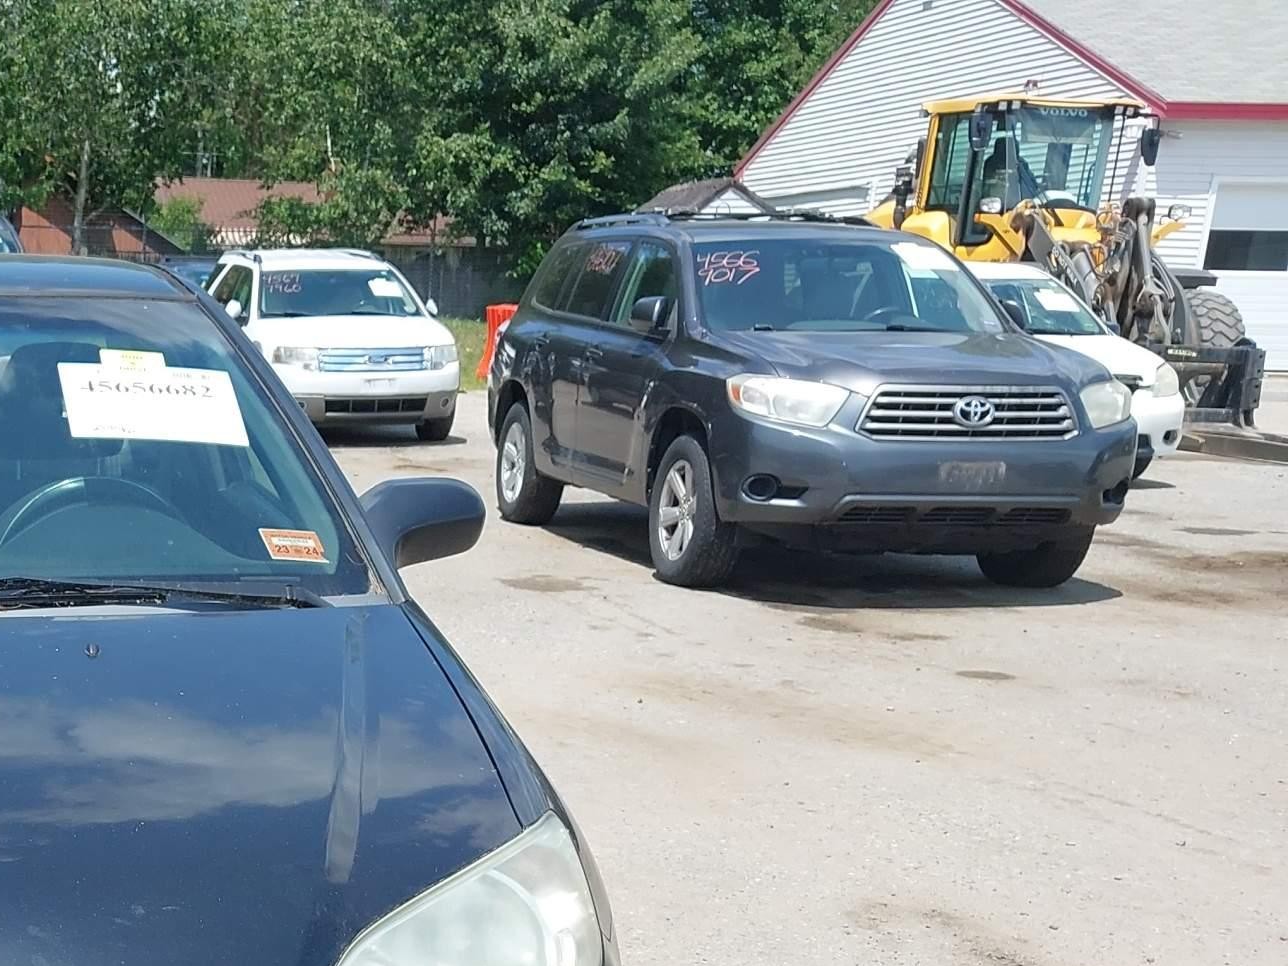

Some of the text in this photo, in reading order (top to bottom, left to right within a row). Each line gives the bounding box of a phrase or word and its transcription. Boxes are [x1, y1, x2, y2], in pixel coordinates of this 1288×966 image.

[1039, 107, 1088, 117] VOLVO
[696, 250, 760, 270] 4566
[698, 267, 760, 285] 9017
[80, 380, 214, 398] 45656682
[275, 545, 319, 555] 23 24
